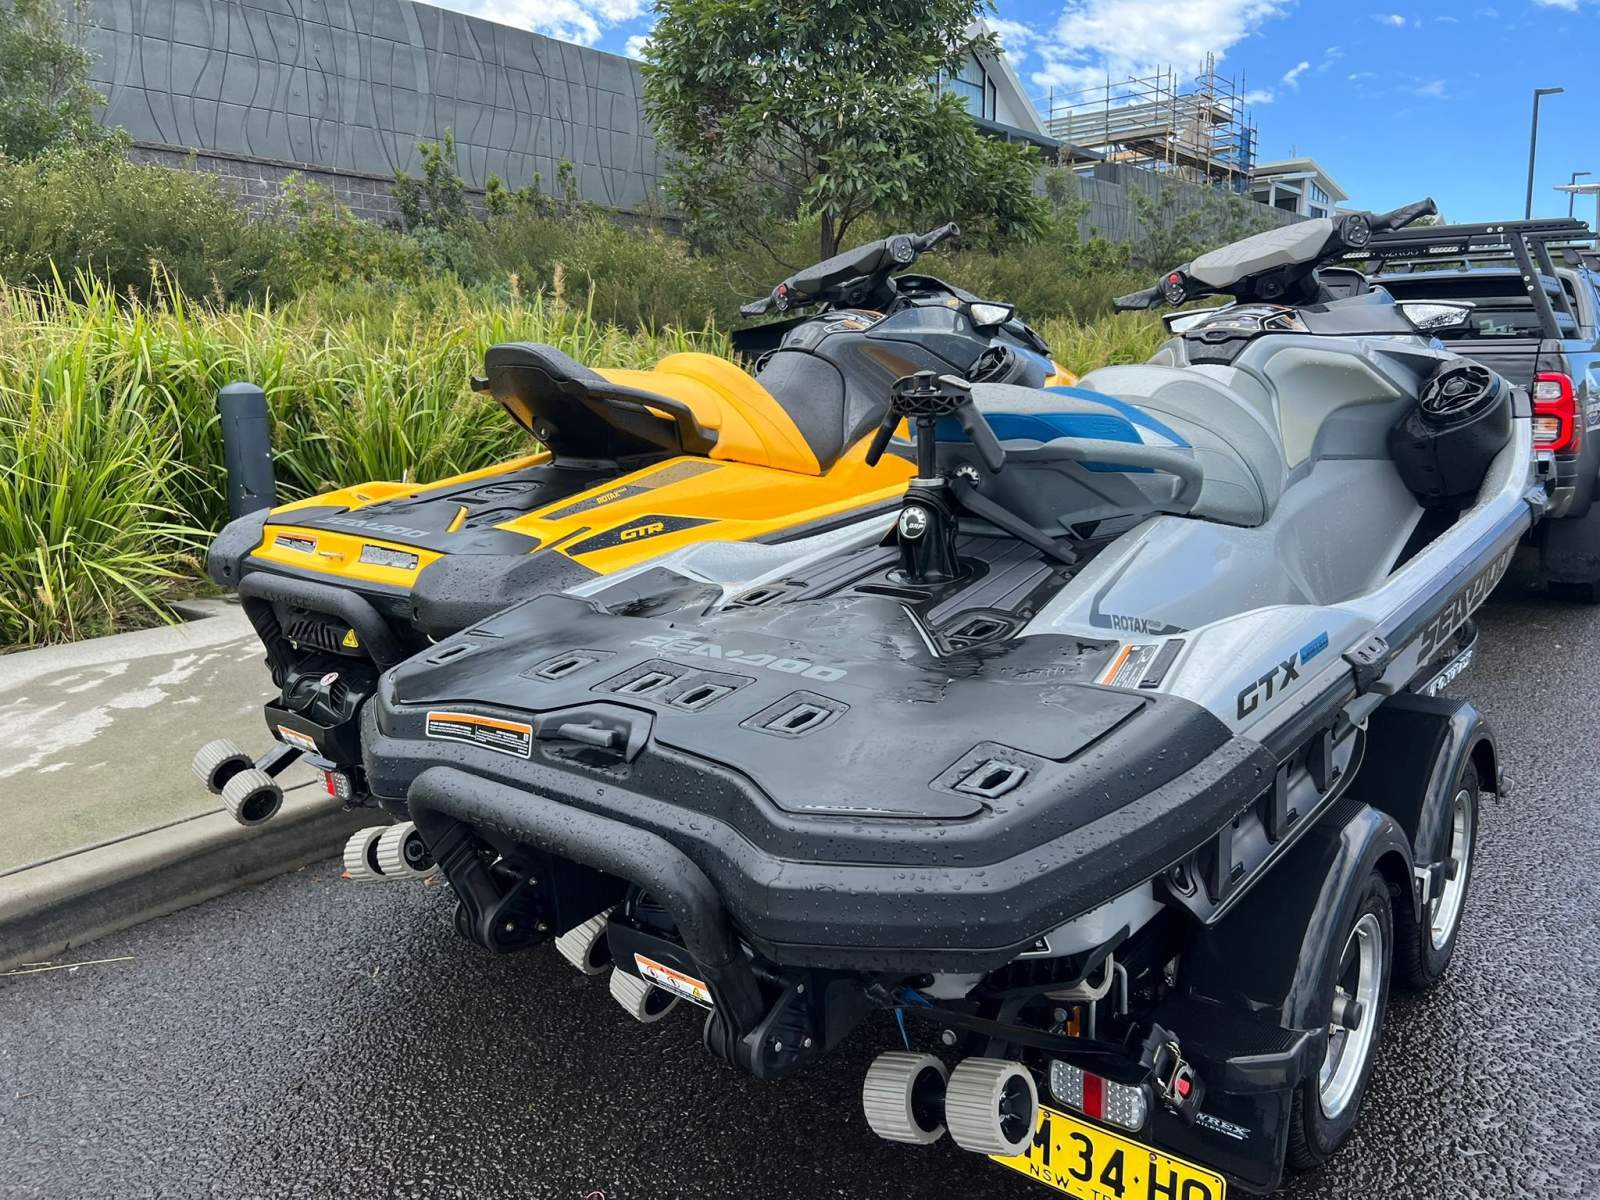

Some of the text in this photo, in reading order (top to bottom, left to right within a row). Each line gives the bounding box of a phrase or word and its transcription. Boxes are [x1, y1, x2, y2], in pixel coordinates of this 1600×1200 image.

[596, 489, 620, 505] ROTAX
[620, 521, 664, 540] GTR
[1111, 614, 1149, 634] ROTAX
[1237, 651, 1300, 721] GTX
[1030, 1163, 1070, 1189] NSW
[1068, 1131, 1126, 1199] 34
